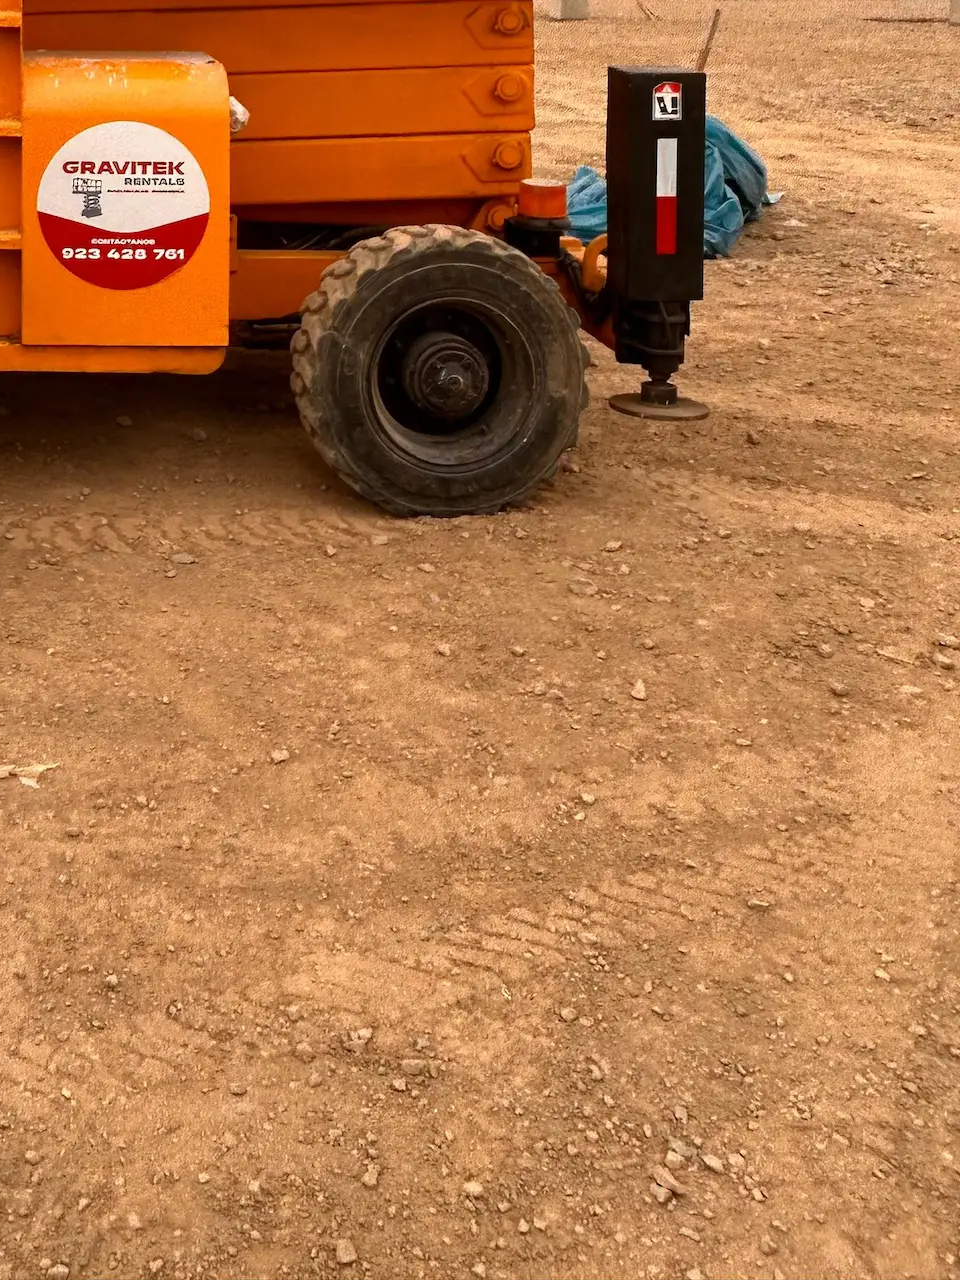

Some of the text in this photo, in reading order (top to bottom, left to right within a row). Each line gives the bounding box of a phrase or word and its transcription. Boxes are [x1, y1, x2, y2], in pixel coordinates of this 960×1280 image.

[62, 161, 185, 175] GRAVITEK
[124, 177, 185, 186] RENTALS
[61, 247, 185, 260] 923 428 761
